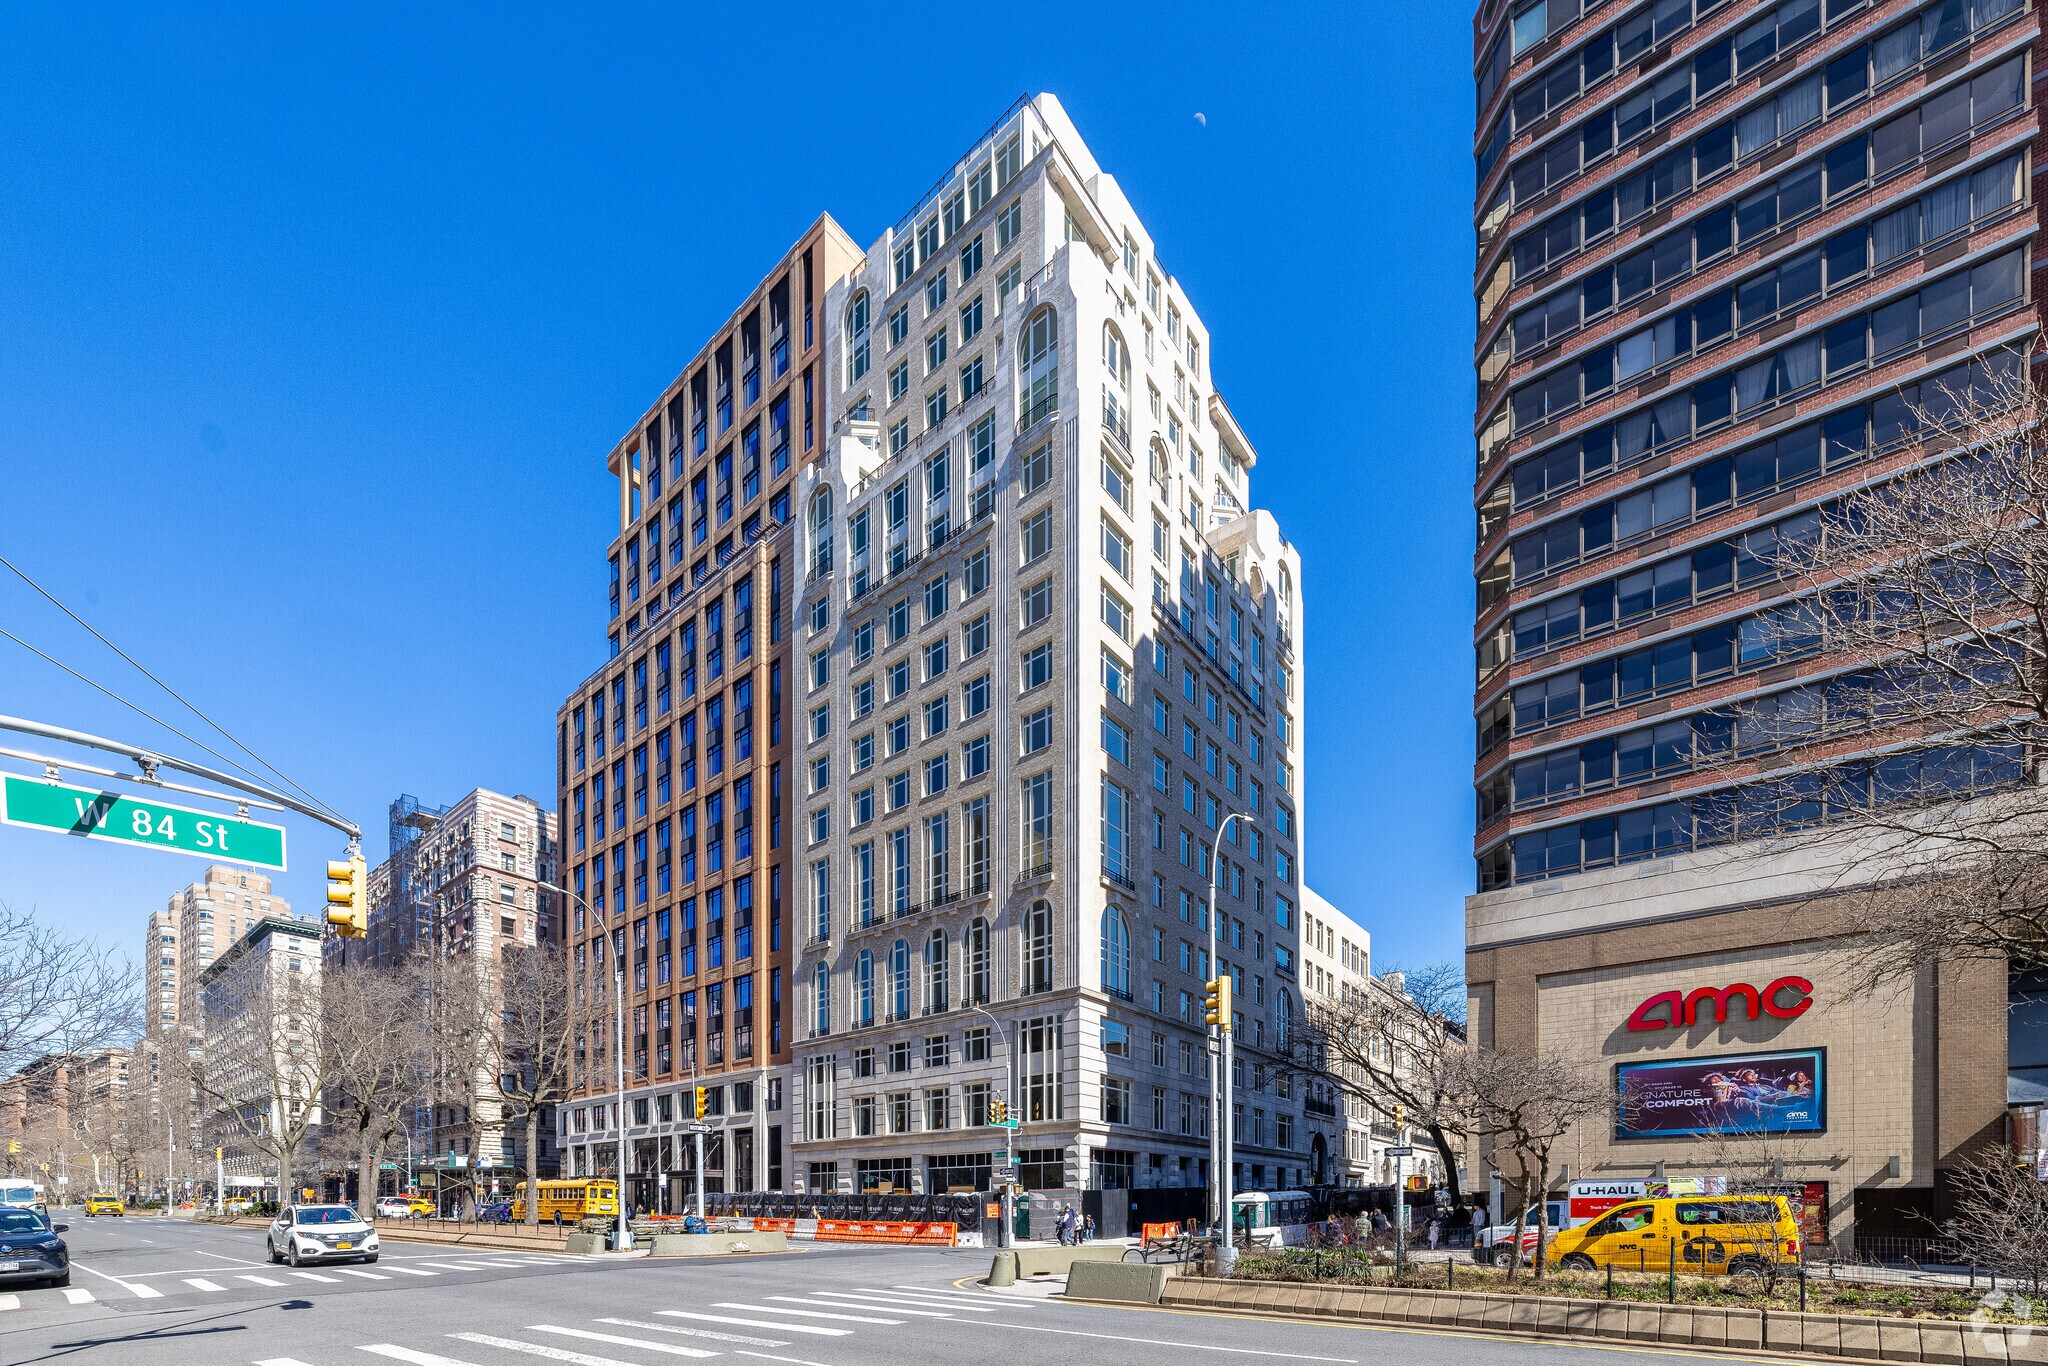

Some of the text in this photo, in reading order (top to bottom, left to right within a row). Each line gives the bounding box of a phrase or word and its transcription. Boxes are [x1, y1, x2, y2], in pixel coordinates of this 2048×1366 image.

[74, 797, 229, 852] W 84 St
[1635, 1089, 1702, 1100] GNATURE
[1646, 1097, 1713, 1108] COMFORT
